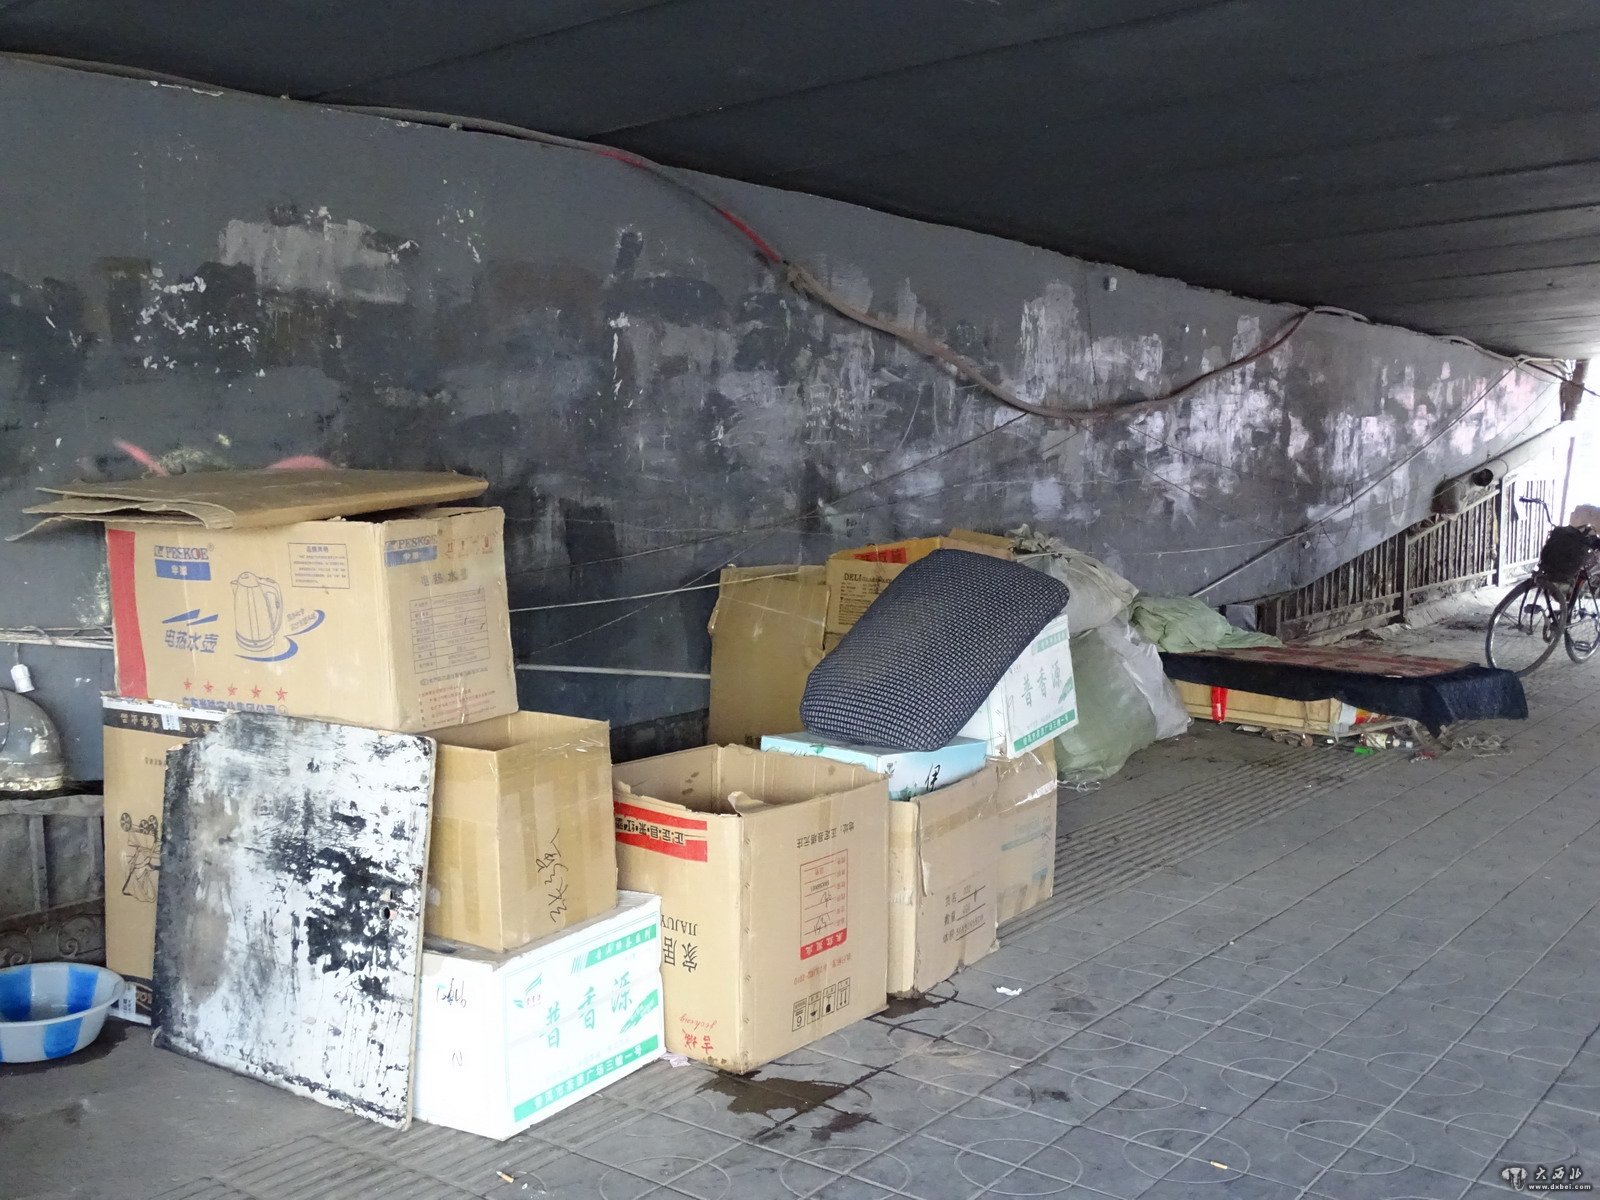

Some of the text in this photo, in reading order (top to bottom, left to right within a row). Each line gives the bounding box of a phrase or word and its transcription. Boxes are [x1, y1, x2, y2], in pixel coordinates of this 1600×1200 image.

[165, 629, 220, 653] 电热水壶
[662, 936, 698, 973] 家居
